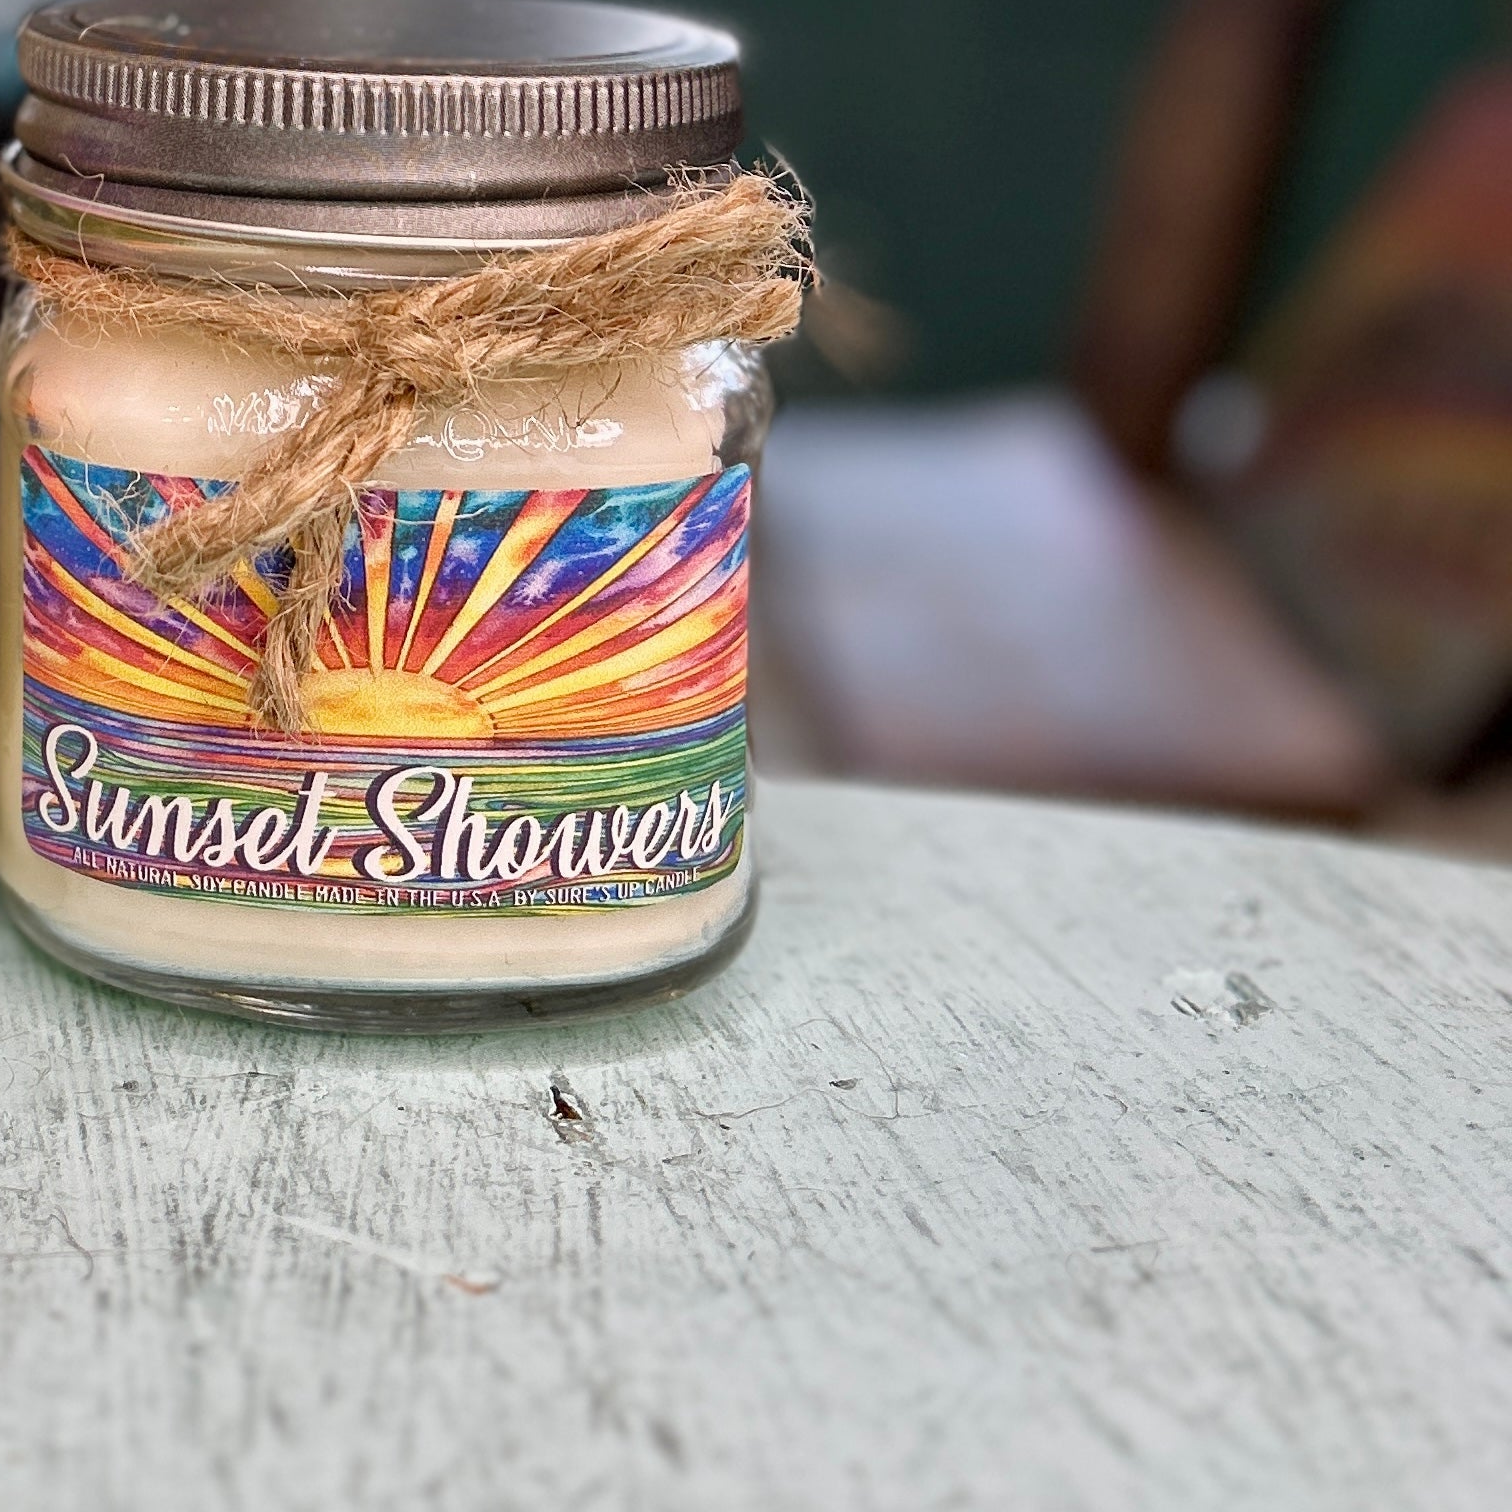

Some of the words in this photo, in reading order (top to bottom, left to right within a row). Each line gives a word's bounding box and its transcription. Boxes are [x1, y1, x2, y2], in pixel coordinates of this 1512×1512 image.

[40, 724, 338, 875] Sunset
[354, 766, 733, 882] Showers
[73, 846, 98, 870] ALL
[106, 856, 179, 888] NATURAL
[190, 874, 226, 893] SOY
[234, 879, 304, 901] CANDLE
[315, 884, 361, 904] MADE
[377, 889, 399, 906] IN
[409, 890, 439, 907] THE
[515, 889, 536, 906] BY
[618, 882, 637, 899] UP
[646, 866, 700, 896] CANDLE
